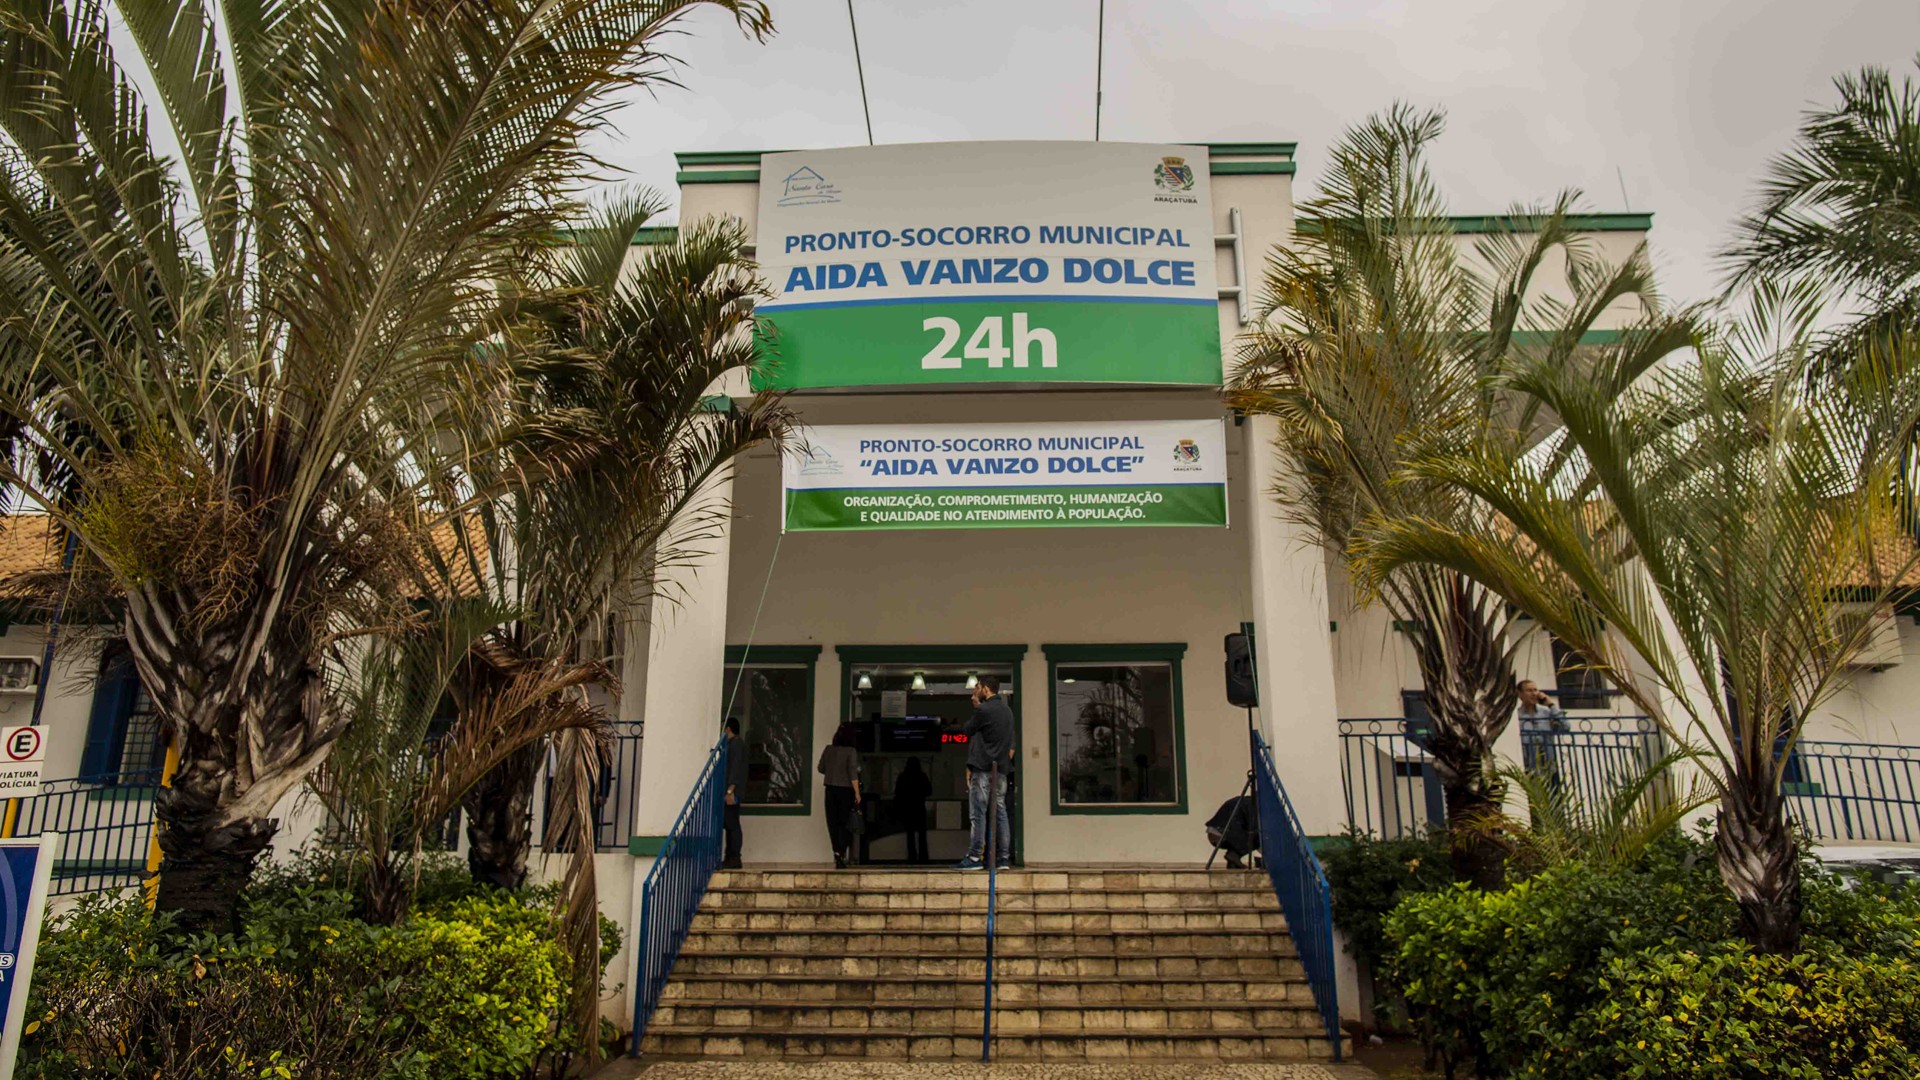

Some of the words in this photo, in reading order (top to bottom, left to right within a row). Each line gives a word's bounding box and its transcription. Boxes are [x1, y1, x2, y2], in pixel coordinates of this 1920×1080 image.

[785, 226, 1031, 254] PRONTO-SOCORRO
[1039, 225, 1190, 248] MUNICIPAL
[784, 261, 888, 293] AIDA
[900, 258, 1049, 286] VANZO
[1063, 258, 1196, 286] DOLCE
[921, 312, 1058, 370] 24h
[860, 437, 1032, 453] PRONTO-SOCORRO
[1038, 436, 1144, 451] MUNICIPAL
[946, 457, 1039, 475] VANZO
[843, 494, 935, 509] ORGANIZAÇÃO,
[938, 493, 1066, 507] COMPROMETIMENTO,
[1070, 491, 1163, 506] HUMANIZAÇÃO
[860, 511, 867, 522] E
[870, 510, 940, 523] QUALIDADE
[943, 510, 962, 521] NO
[965, 508, 1053, 521] ATENDIMENTO
[1056, 507, 1066, 519] À
[1069, 507, 1146, 521] POPULAÇÃO.
[14, 734, 32, 753] E
[0, 779, 37, 789] OLÍCIAL
